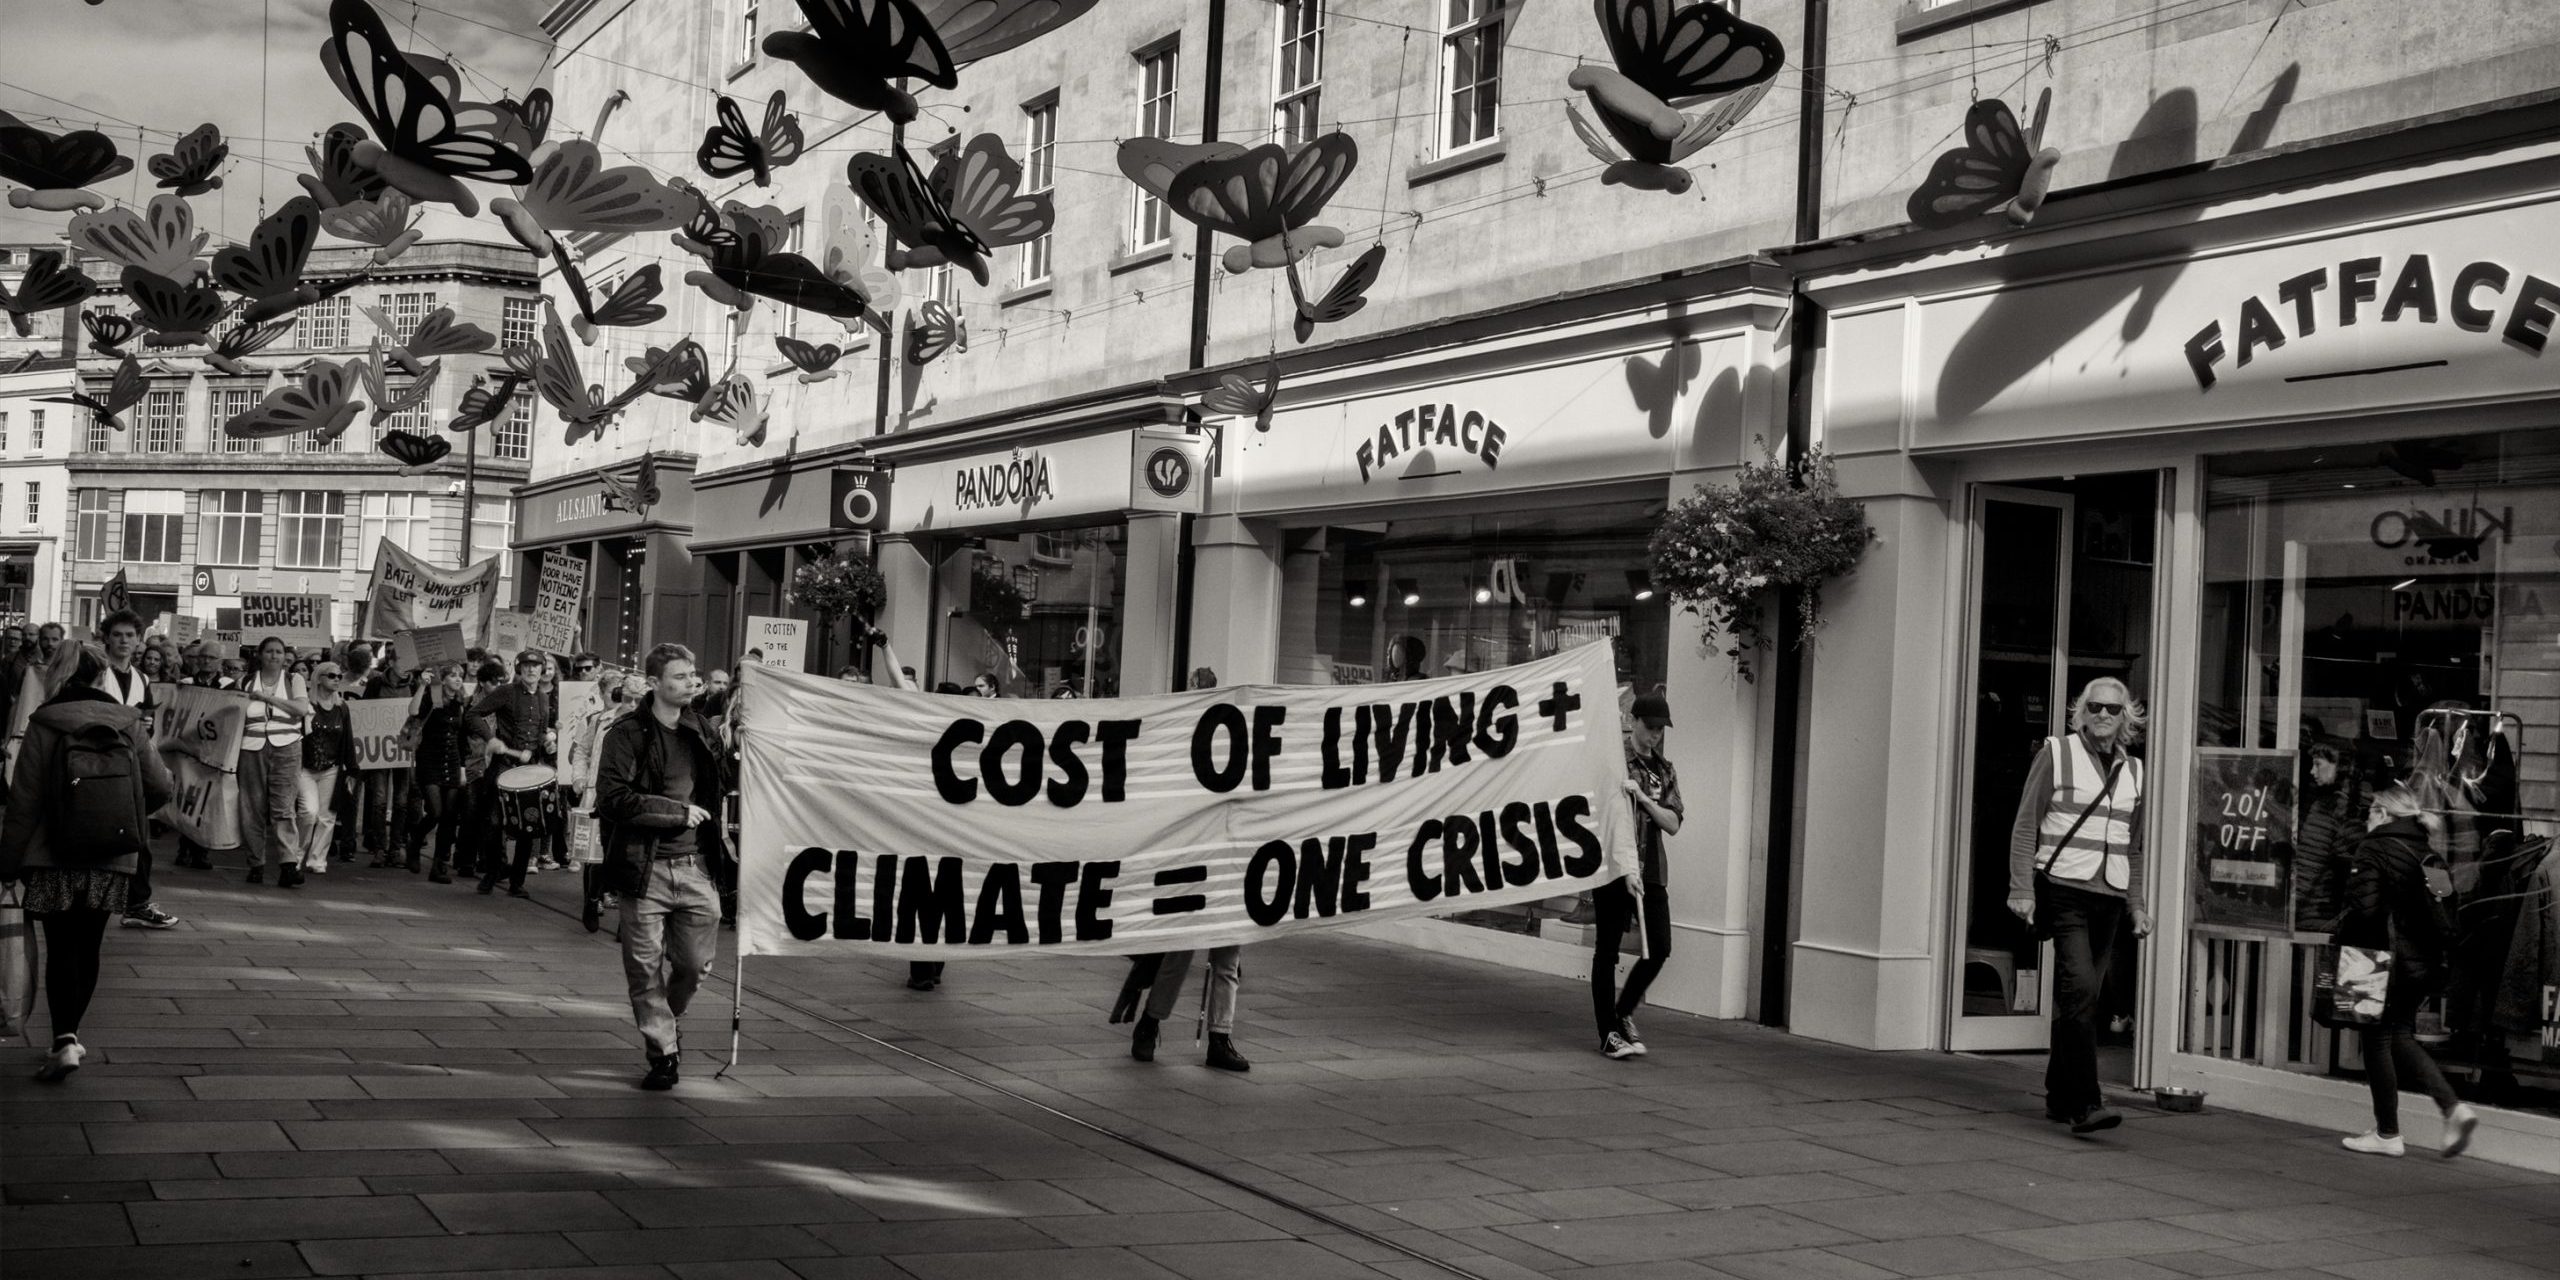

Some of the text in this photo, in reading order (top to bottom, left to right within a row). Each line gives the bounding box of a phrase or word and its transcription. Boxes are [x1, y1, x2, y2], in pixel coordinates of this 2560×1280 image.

[2184, 254, 2560, 393] FATFACE
[1356, 404, 1507, 484] FATFACE
[956, 456, 1053, 507] PANDORA
[544, 553, 584, 572] WHEN THE
[198, 577, 206, 586] BT
[384, 562, 415, 589] BATH
[543, 566, 582, 586] POOR HAVE
[392, 588, 417, 602] LEFT
[541, 578, 579, 600] NOTHING
[243, 595, 323, 614] ENOUGH IS
[539, 594, 576, 615] TO EAT
[2394, 588, 2543, 621] PANDOA
[535, 609, 572, 628] WE WILL
[532, 621, 570, 640] EAT THE
[764, 623, 797, 636] ROTTEN
[1541, 616, 1620, 651] NOT COMING IN
[535, 633, 565, 653] RICH!
[764, 642, 788, 650] TO THE
[931, 718, 1142, 808] COST
[1191, 703, 1286, 793] OF
[1321, 684, 1520, 790] LIVING
[2222, 785, 2268, 820] 20%
[2221, 824, 2267, 851] OFF
[782, 847, 1121, 944] CLIMATE
[1243, 832, 1377, 927] ONE
[1407, 794, 1603, 901] CRISIS
